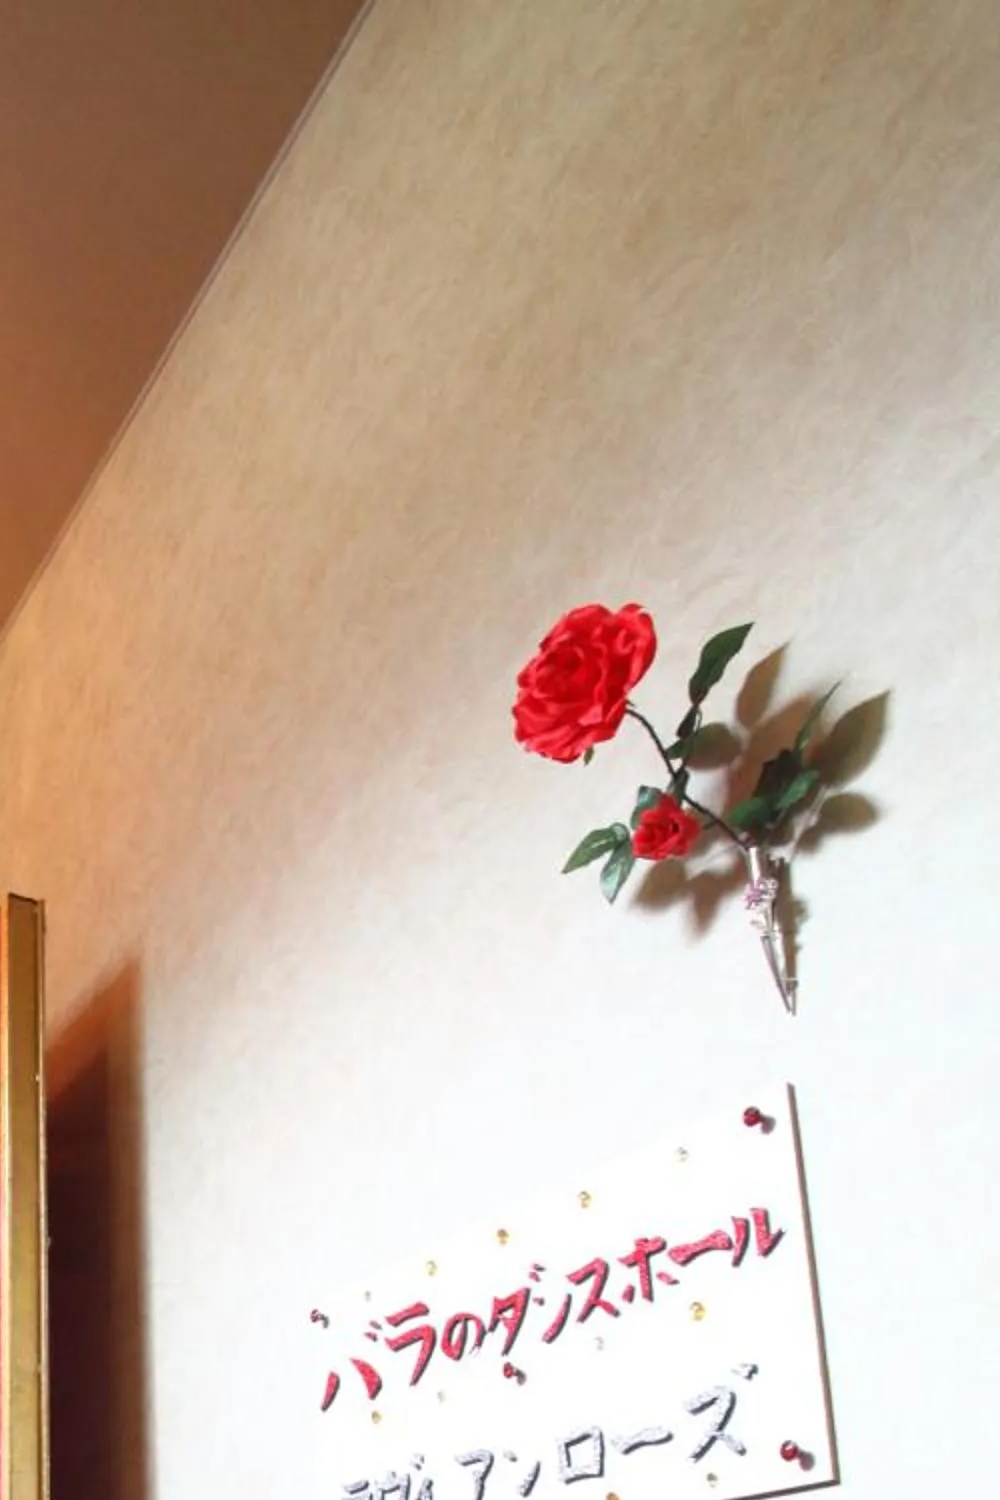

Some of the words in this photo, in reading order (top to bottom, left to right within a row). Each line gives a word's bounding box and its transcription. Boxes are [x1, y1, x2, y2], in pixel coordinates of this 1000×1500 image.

[320, 1207, 786, 1412] バラのダンスホール
